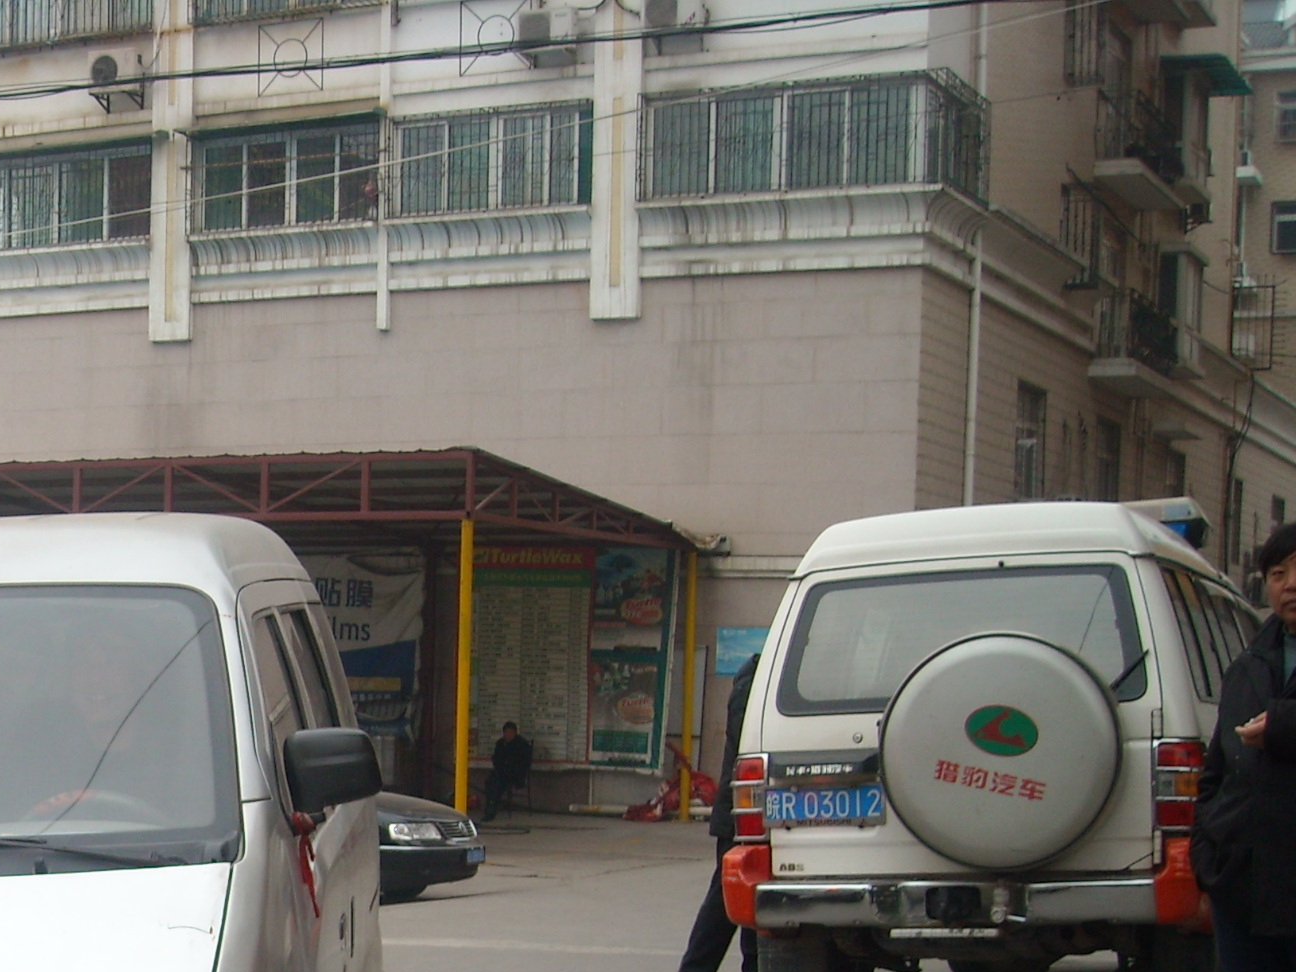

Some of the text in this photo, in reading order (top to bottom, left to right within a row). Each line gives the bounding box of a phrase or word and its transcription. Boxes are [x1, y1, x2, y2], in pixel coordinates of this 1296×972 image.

[316, 577, 374, 608] 贴膜
[328, 616, 372, 641] lms
[934, 759, 1046, 801] 猎豹汽车
[778, 862, 805, 873] ABS
